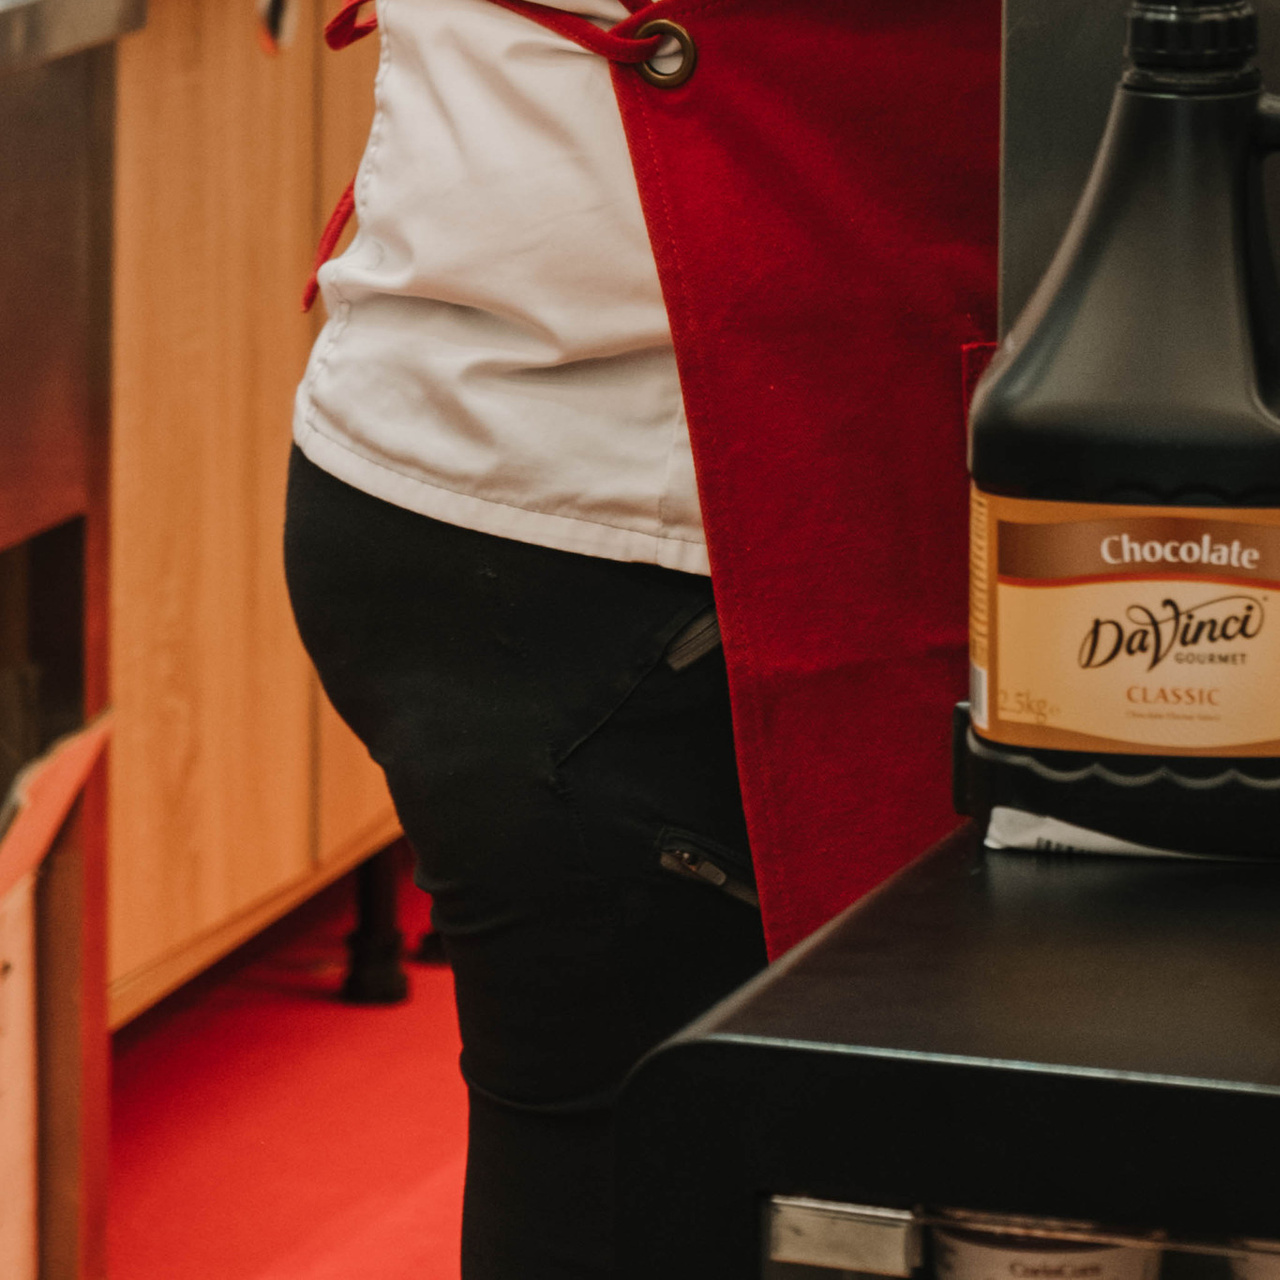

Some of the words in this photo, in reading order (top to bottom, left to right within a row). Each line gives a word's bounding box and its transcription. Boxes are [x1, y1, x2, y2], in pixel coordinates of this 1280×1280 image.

[1100, 533, 1261, 570] Chocolate
[1078, 594, 1265, 673] DaVinci
[1174, 652, 1247, 665] GOURMET
[1126, 685, 1220, 707] CLASSIC
